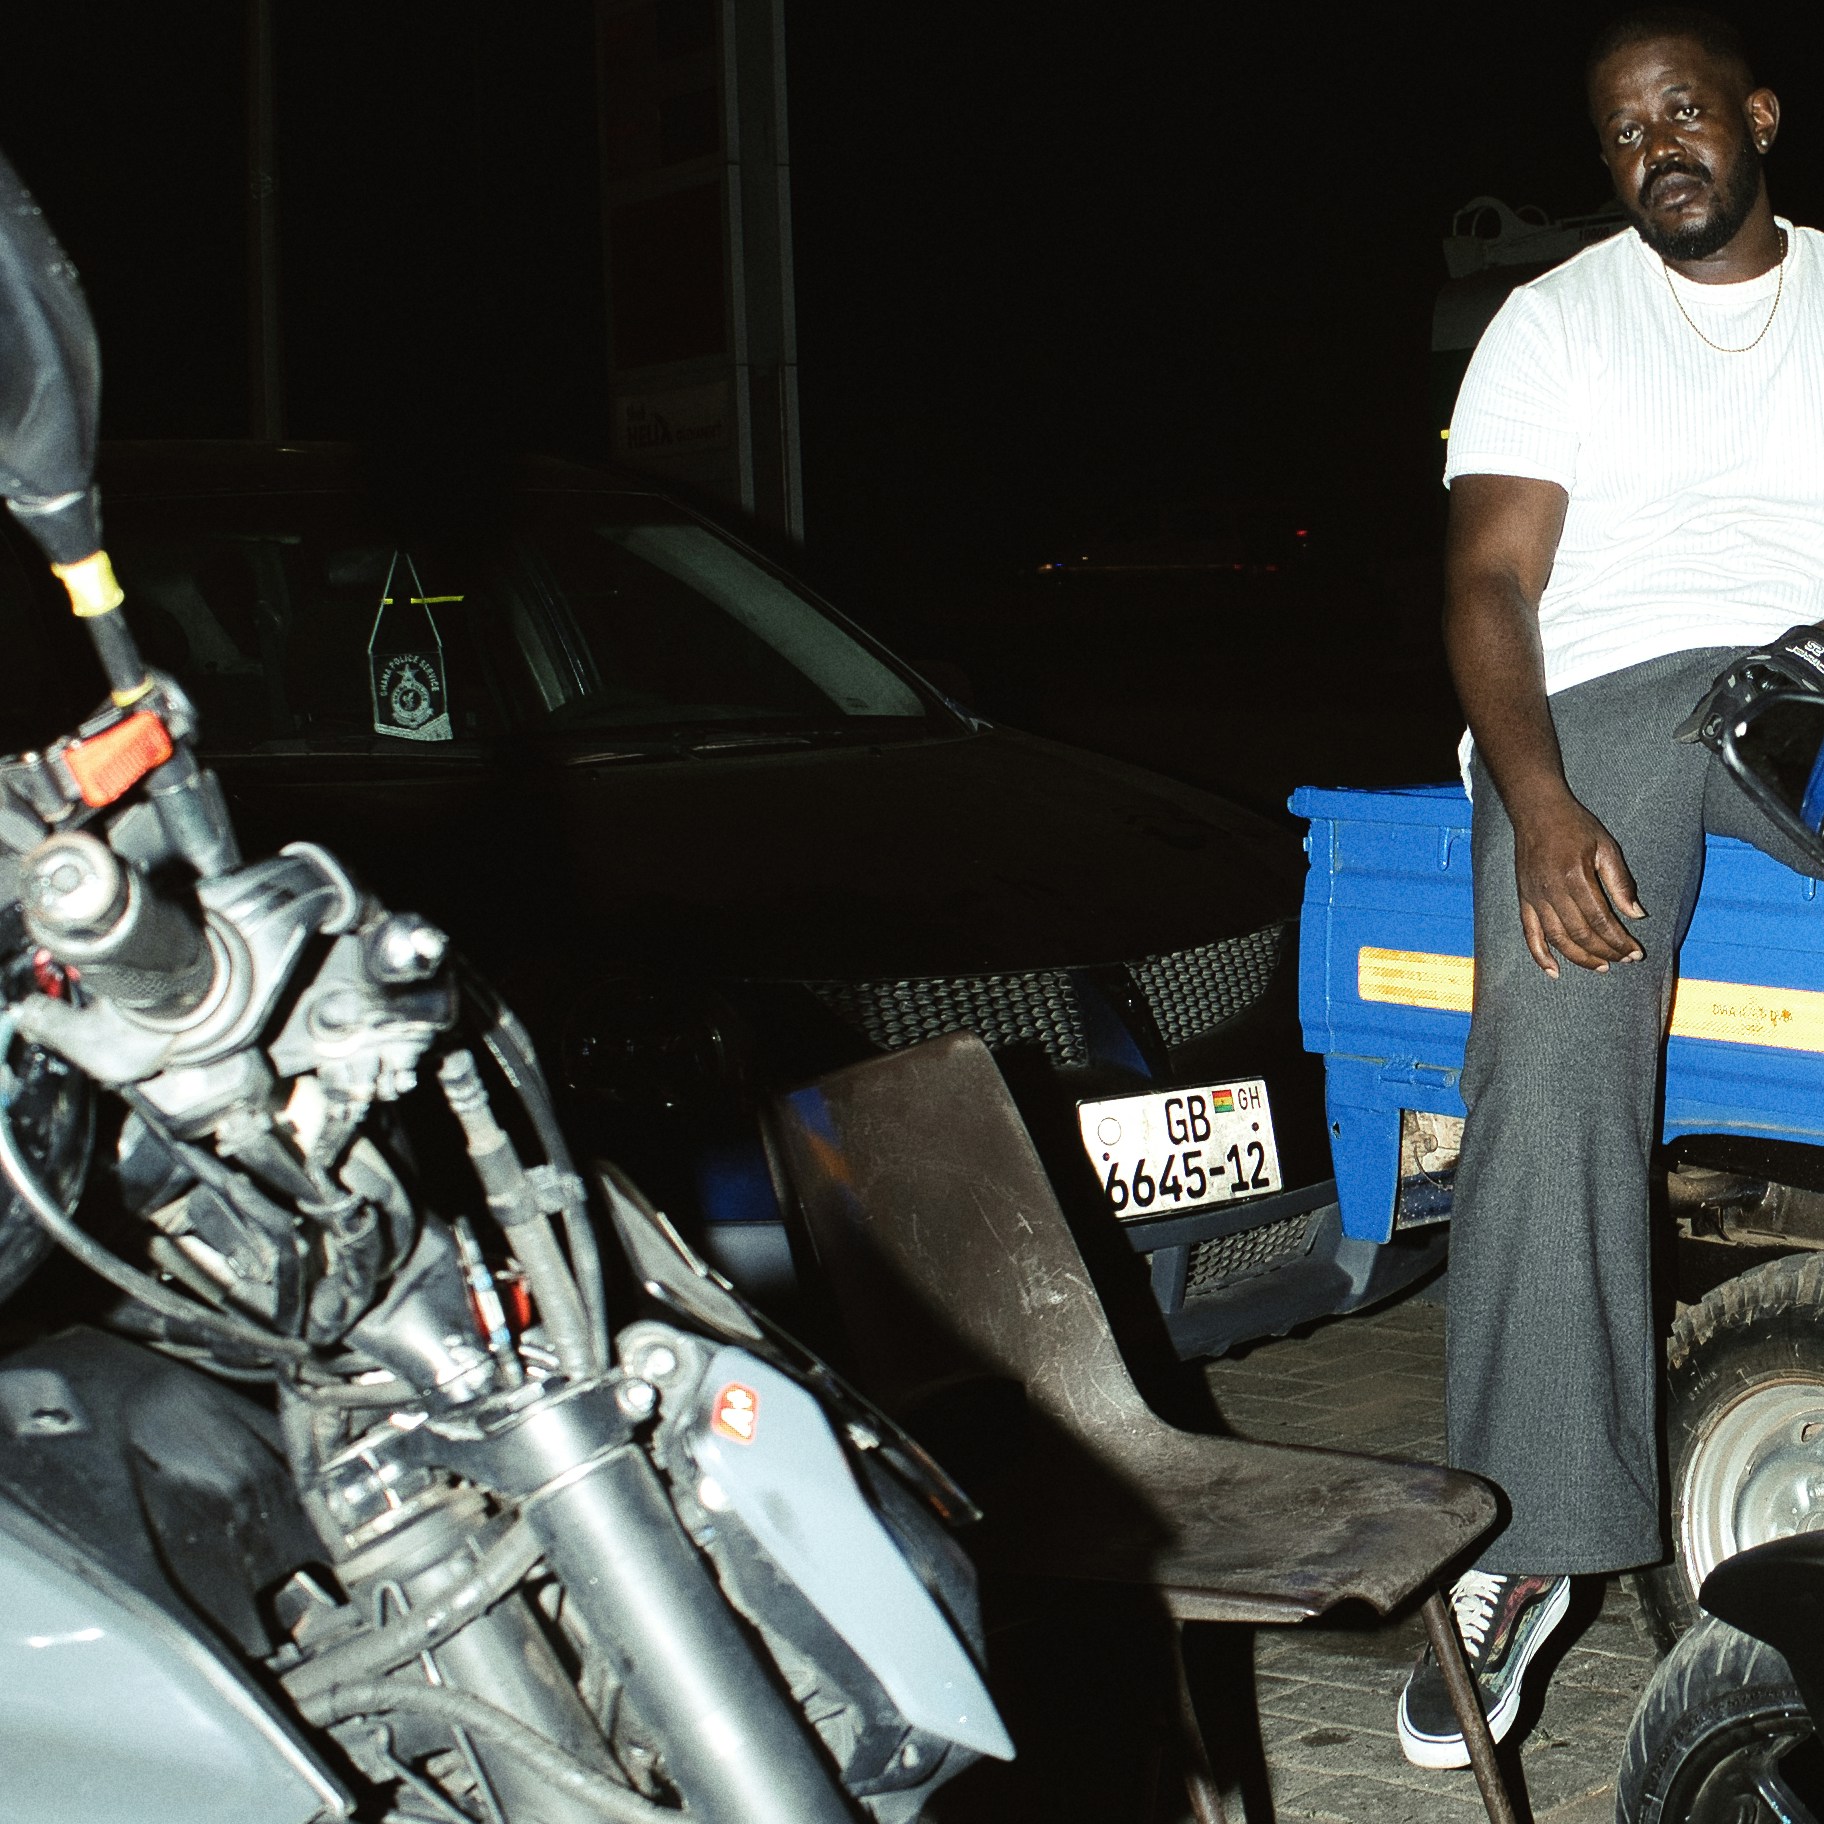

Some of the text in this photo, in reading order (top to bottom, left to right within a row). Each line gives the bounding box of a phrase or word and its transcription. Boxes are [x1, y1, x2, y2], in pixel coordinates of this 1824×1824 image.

[626, 414, 673, 449] HELIX
[380, 668, 392, 697] GHANA
[389, 654, 420, 671] POLICE
[419, 660, 440, 692] SERVICE
[1237, 1086, 1261, 1110] GH
[1164, 1095, 1211, 1145] GB
[1104, 1141, 1269, 1212] 6645-12
